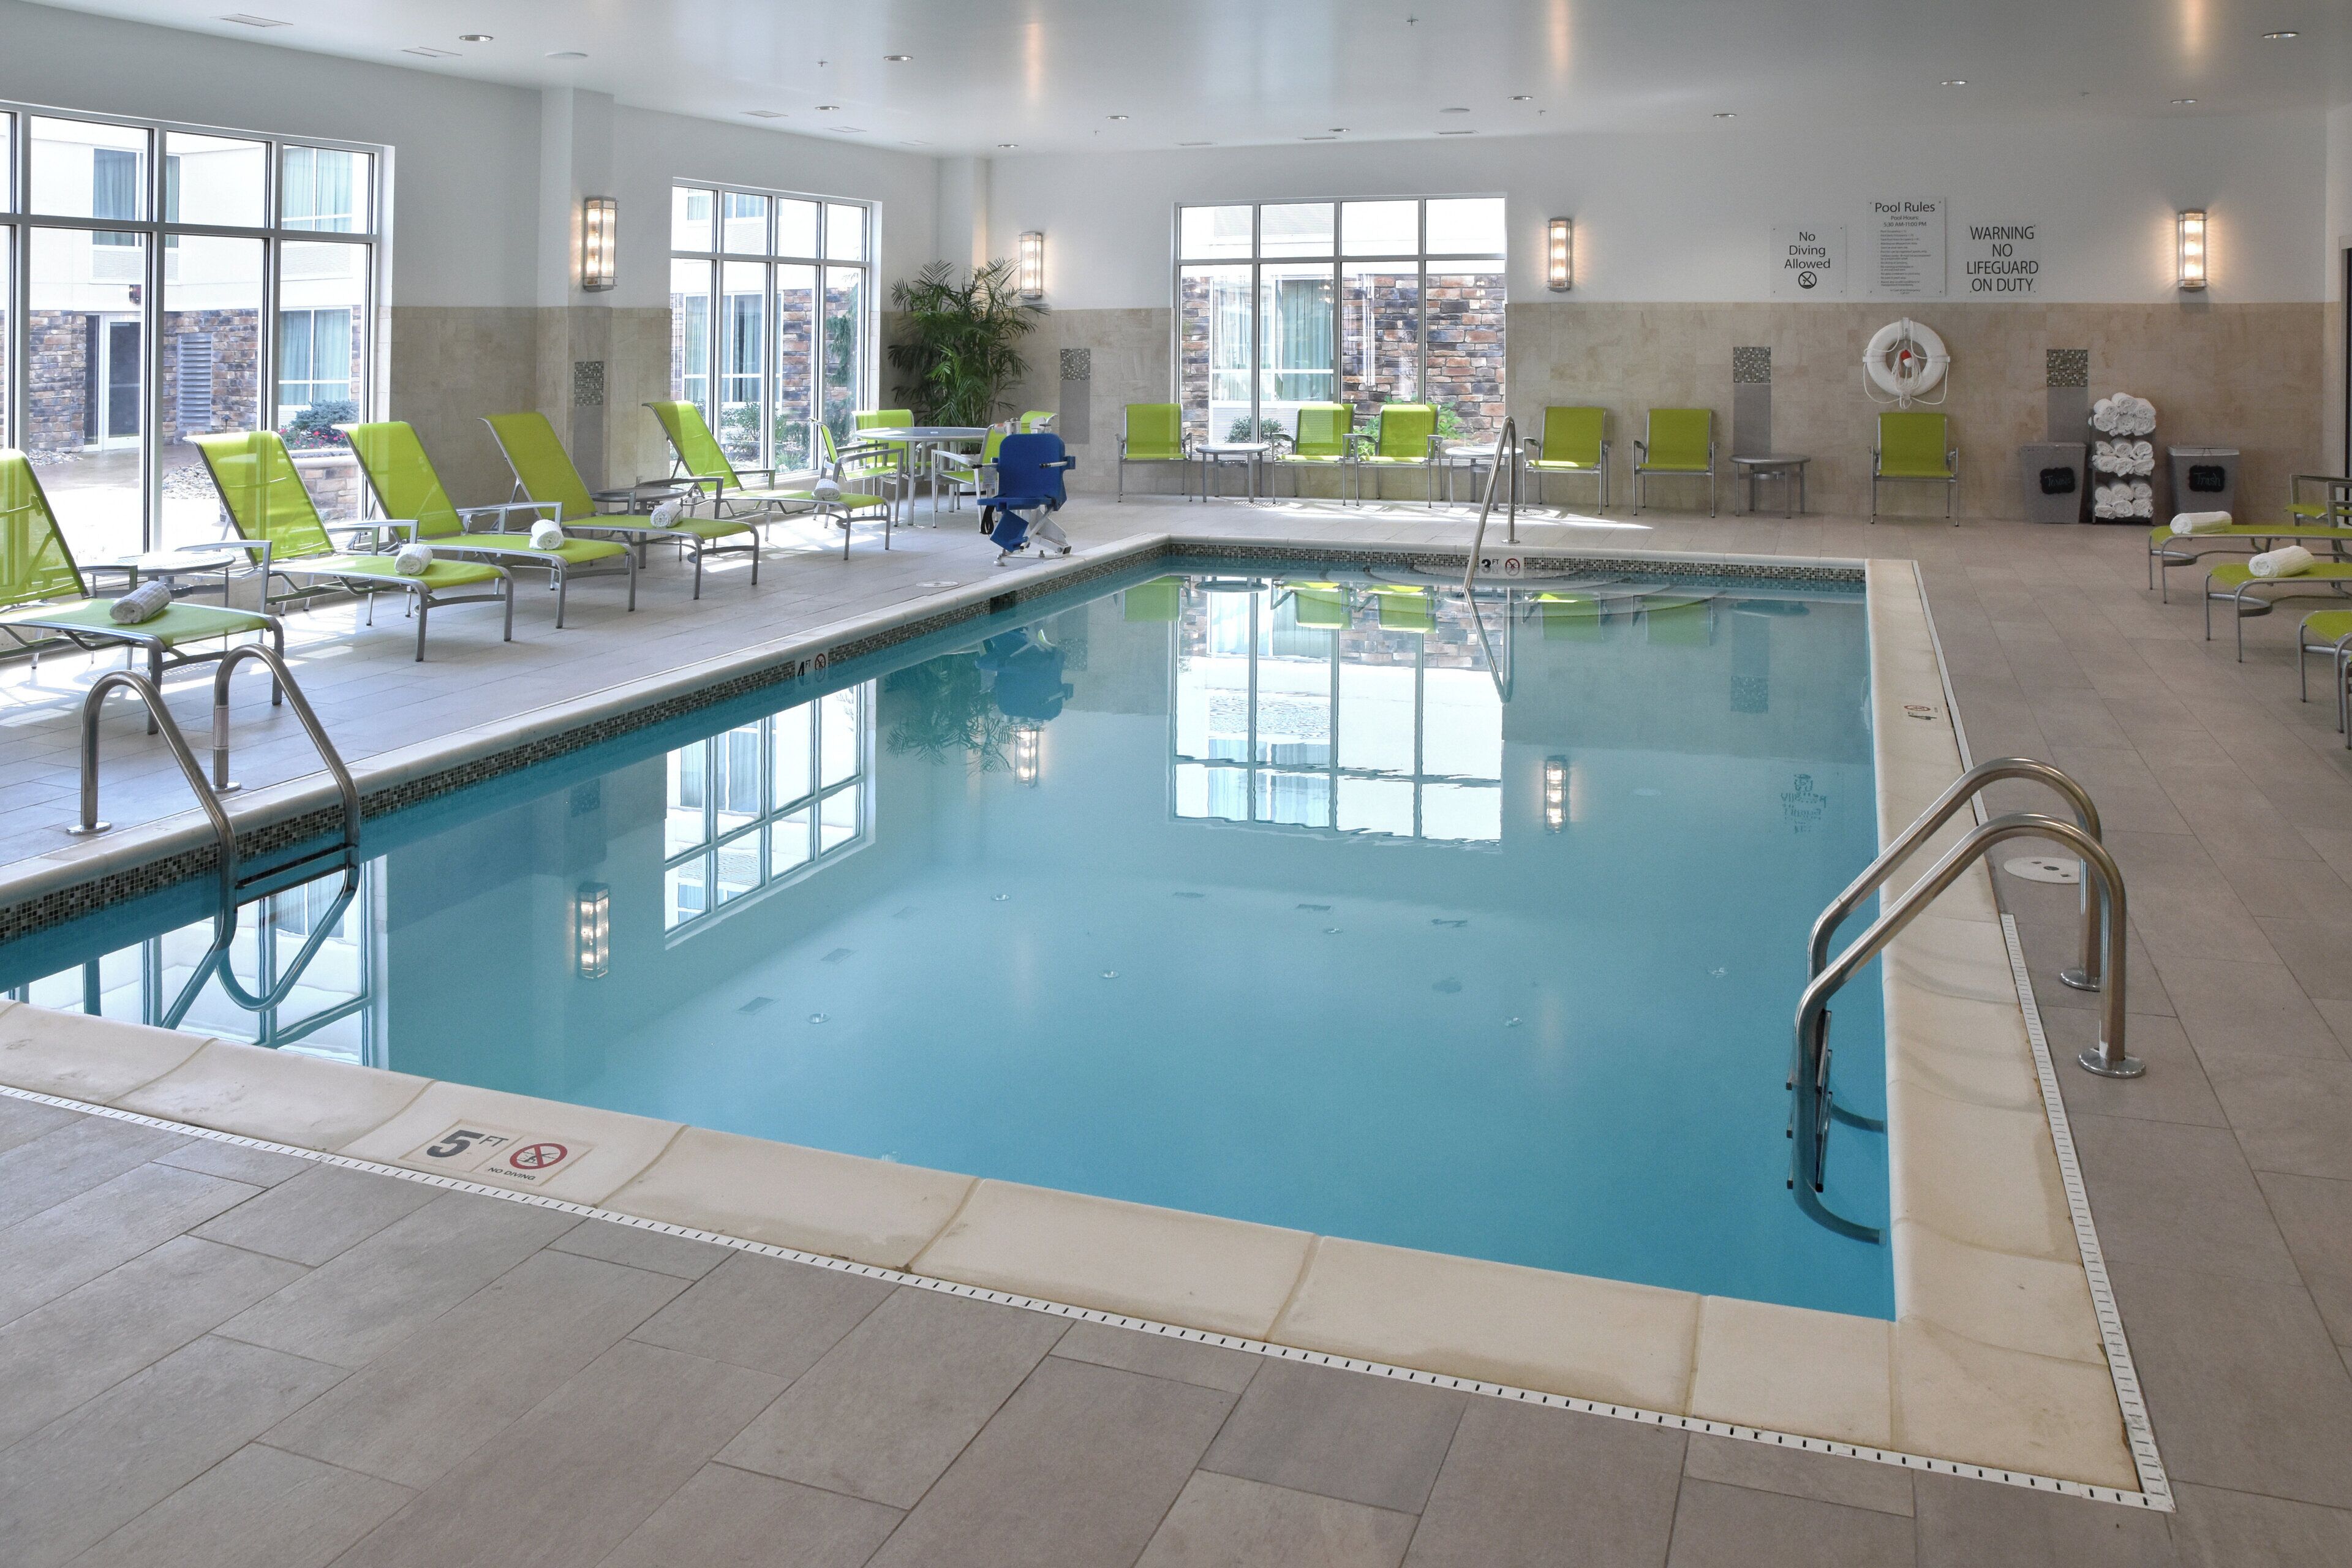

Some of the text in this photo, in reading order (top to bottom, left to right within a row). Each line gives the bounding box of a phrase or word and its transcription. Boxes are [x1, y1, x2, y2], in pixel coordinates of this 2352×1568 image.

[1875, 202, 1936, 213] Pool Rules
[1799, 232, 1816, 241] No
[1970, 226, 2034, 240] WARNING
[1789, 245, 1826, 258] Diving
[1992, 243, 2013, 257] NO
[1785, 258, 1831, 269] Allowed
[1967, 260, 2039, 274] LIFEGUARD
[1972, 278, 2034, 292] ON DUTY
[2193, 472, 2221, 487] Trash
[805, 659, 811, 668] FT
[426, 1129, 509, 1158] 5 FT
[503, 1170, 536, 1180] DIVING
